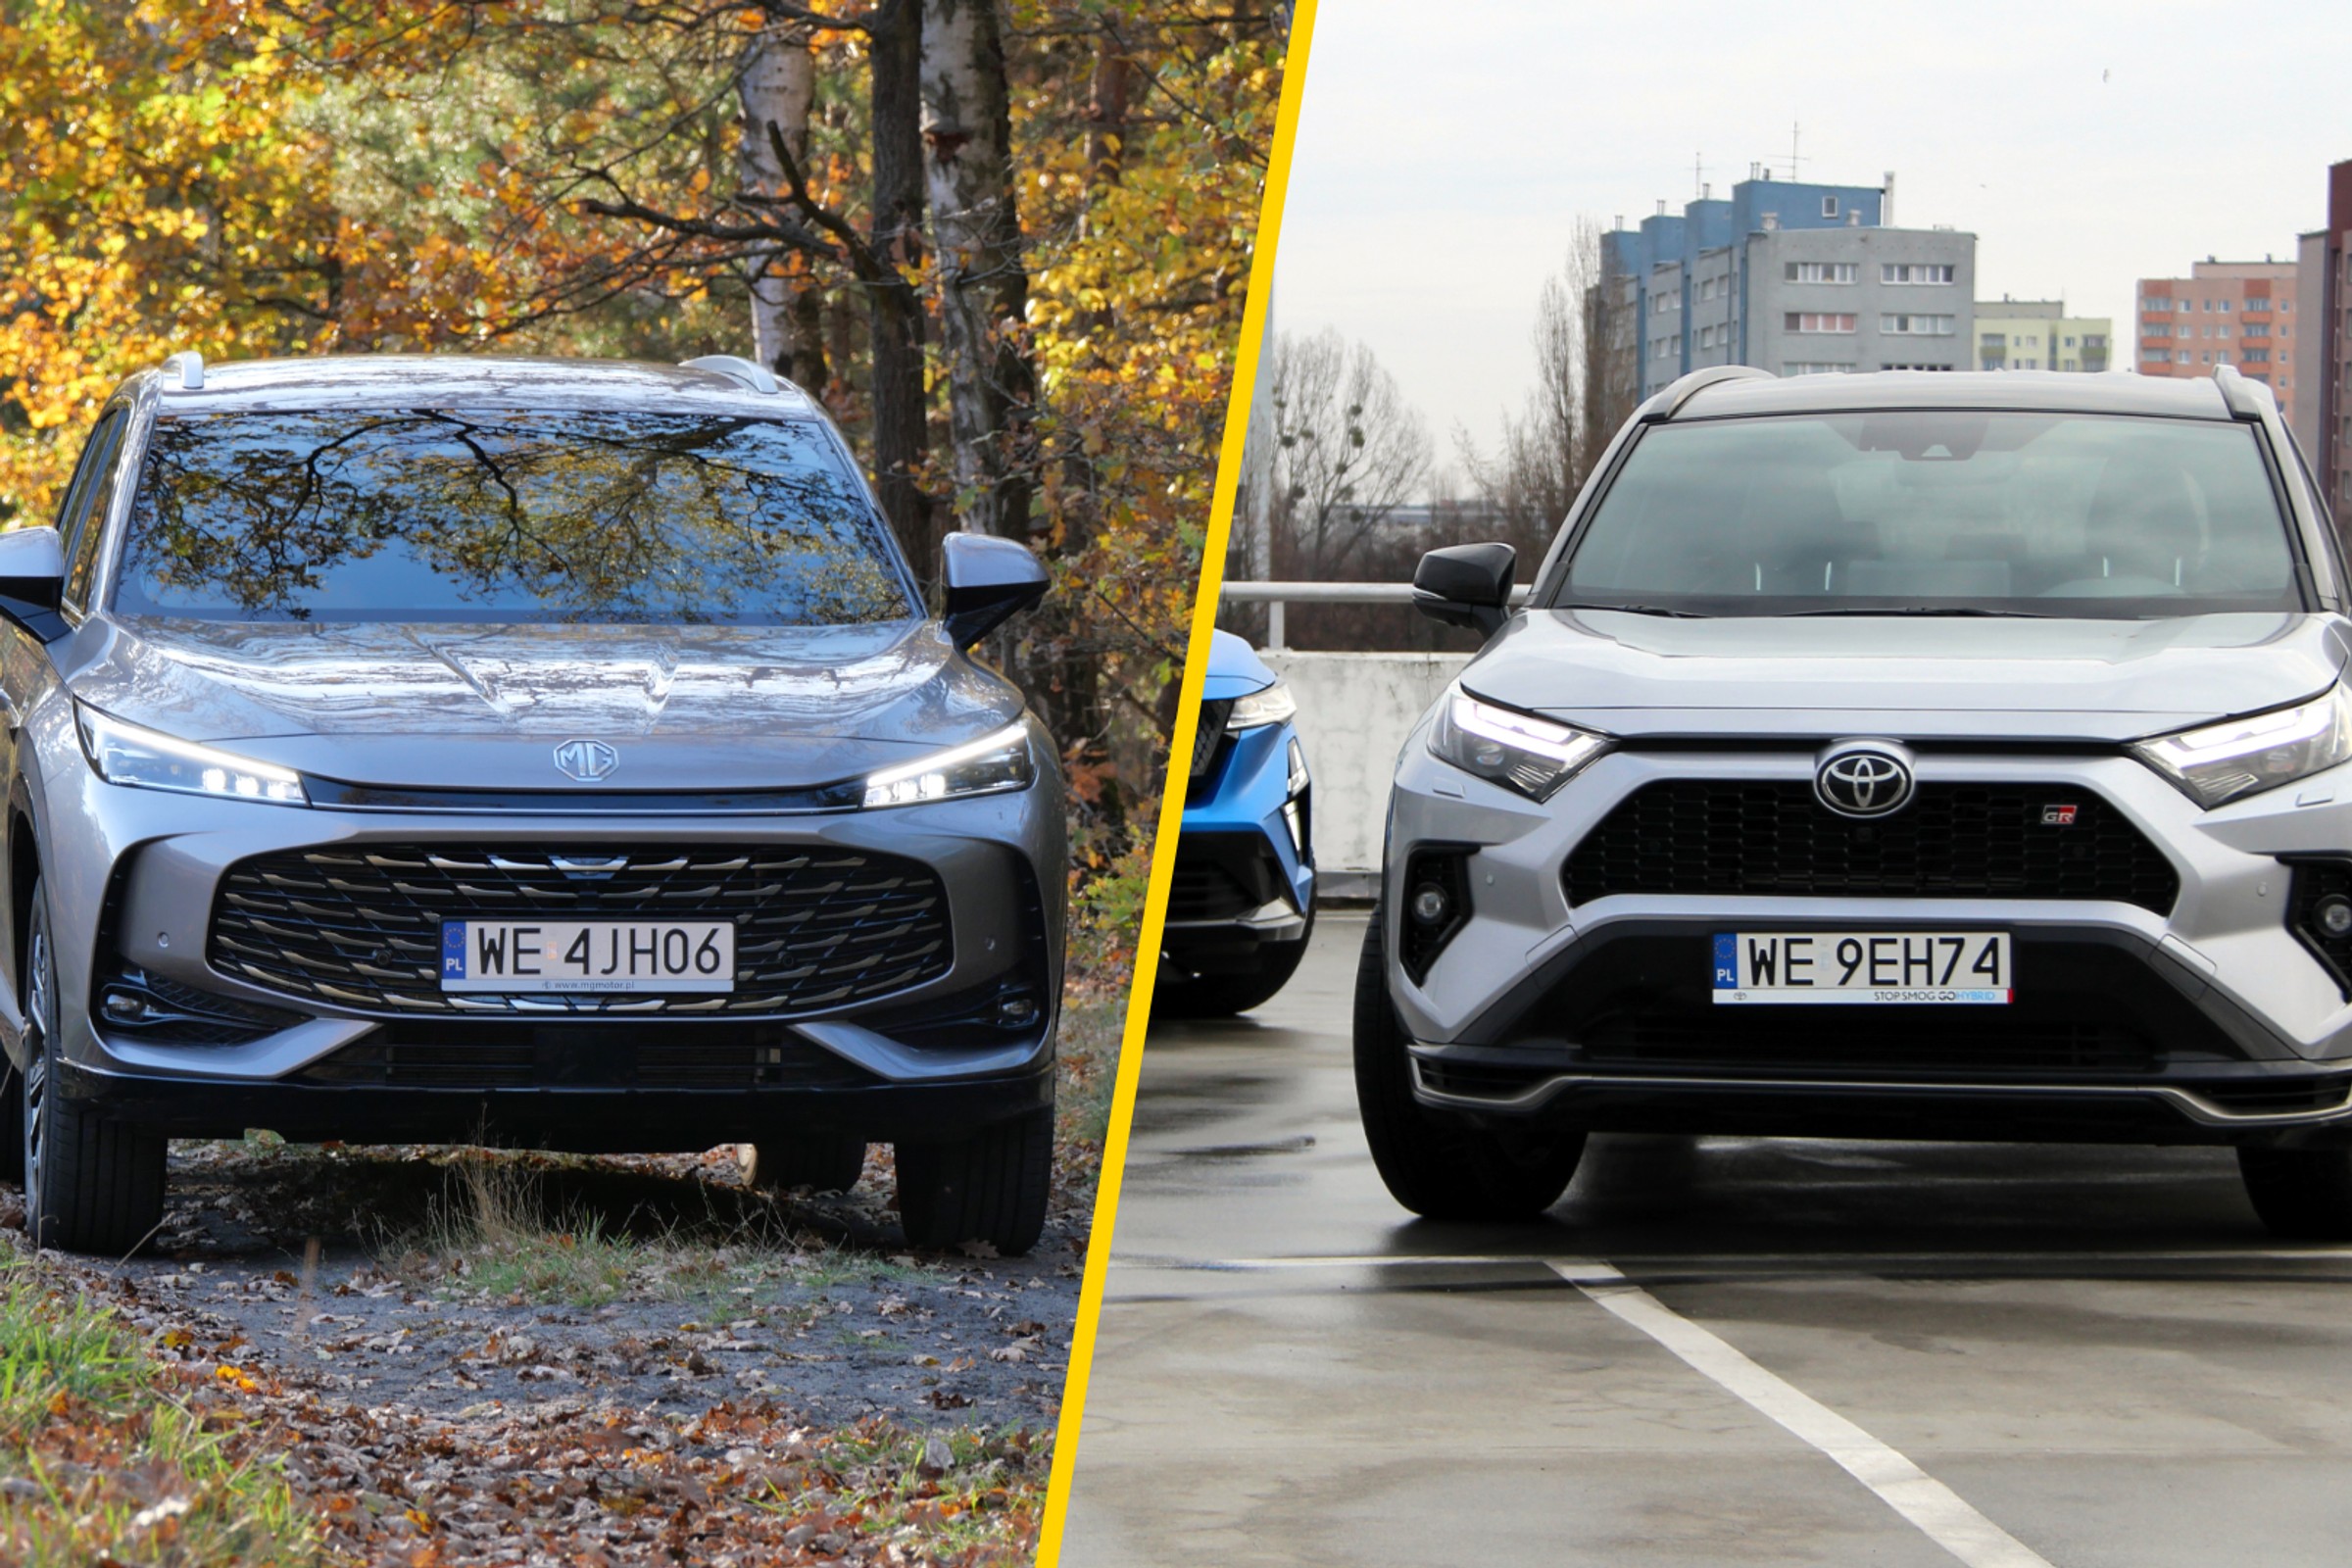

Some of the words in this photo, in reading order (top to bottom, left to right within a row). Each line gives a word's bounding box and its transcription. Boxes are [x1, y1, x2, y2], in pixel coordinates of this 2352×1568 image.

[560, 742, 612, 776] MG
[2042, 810, 2075, 824] GR
[477, 927, 541, 975] WE
[564, 927, 721, 975] 4JH06
[446, 957, 464, 971] PL
[1748, 938, 1814, 986] WE
[1837, 937, 2000, 986] 9EH74
[1716, 968, 1735, 982] PL
[554, 980, 635, 991] www.mgmotor.pl
[1874, 991, 1900, 1001] STOP
[1902, 991, 1936, 1001] SMOG
